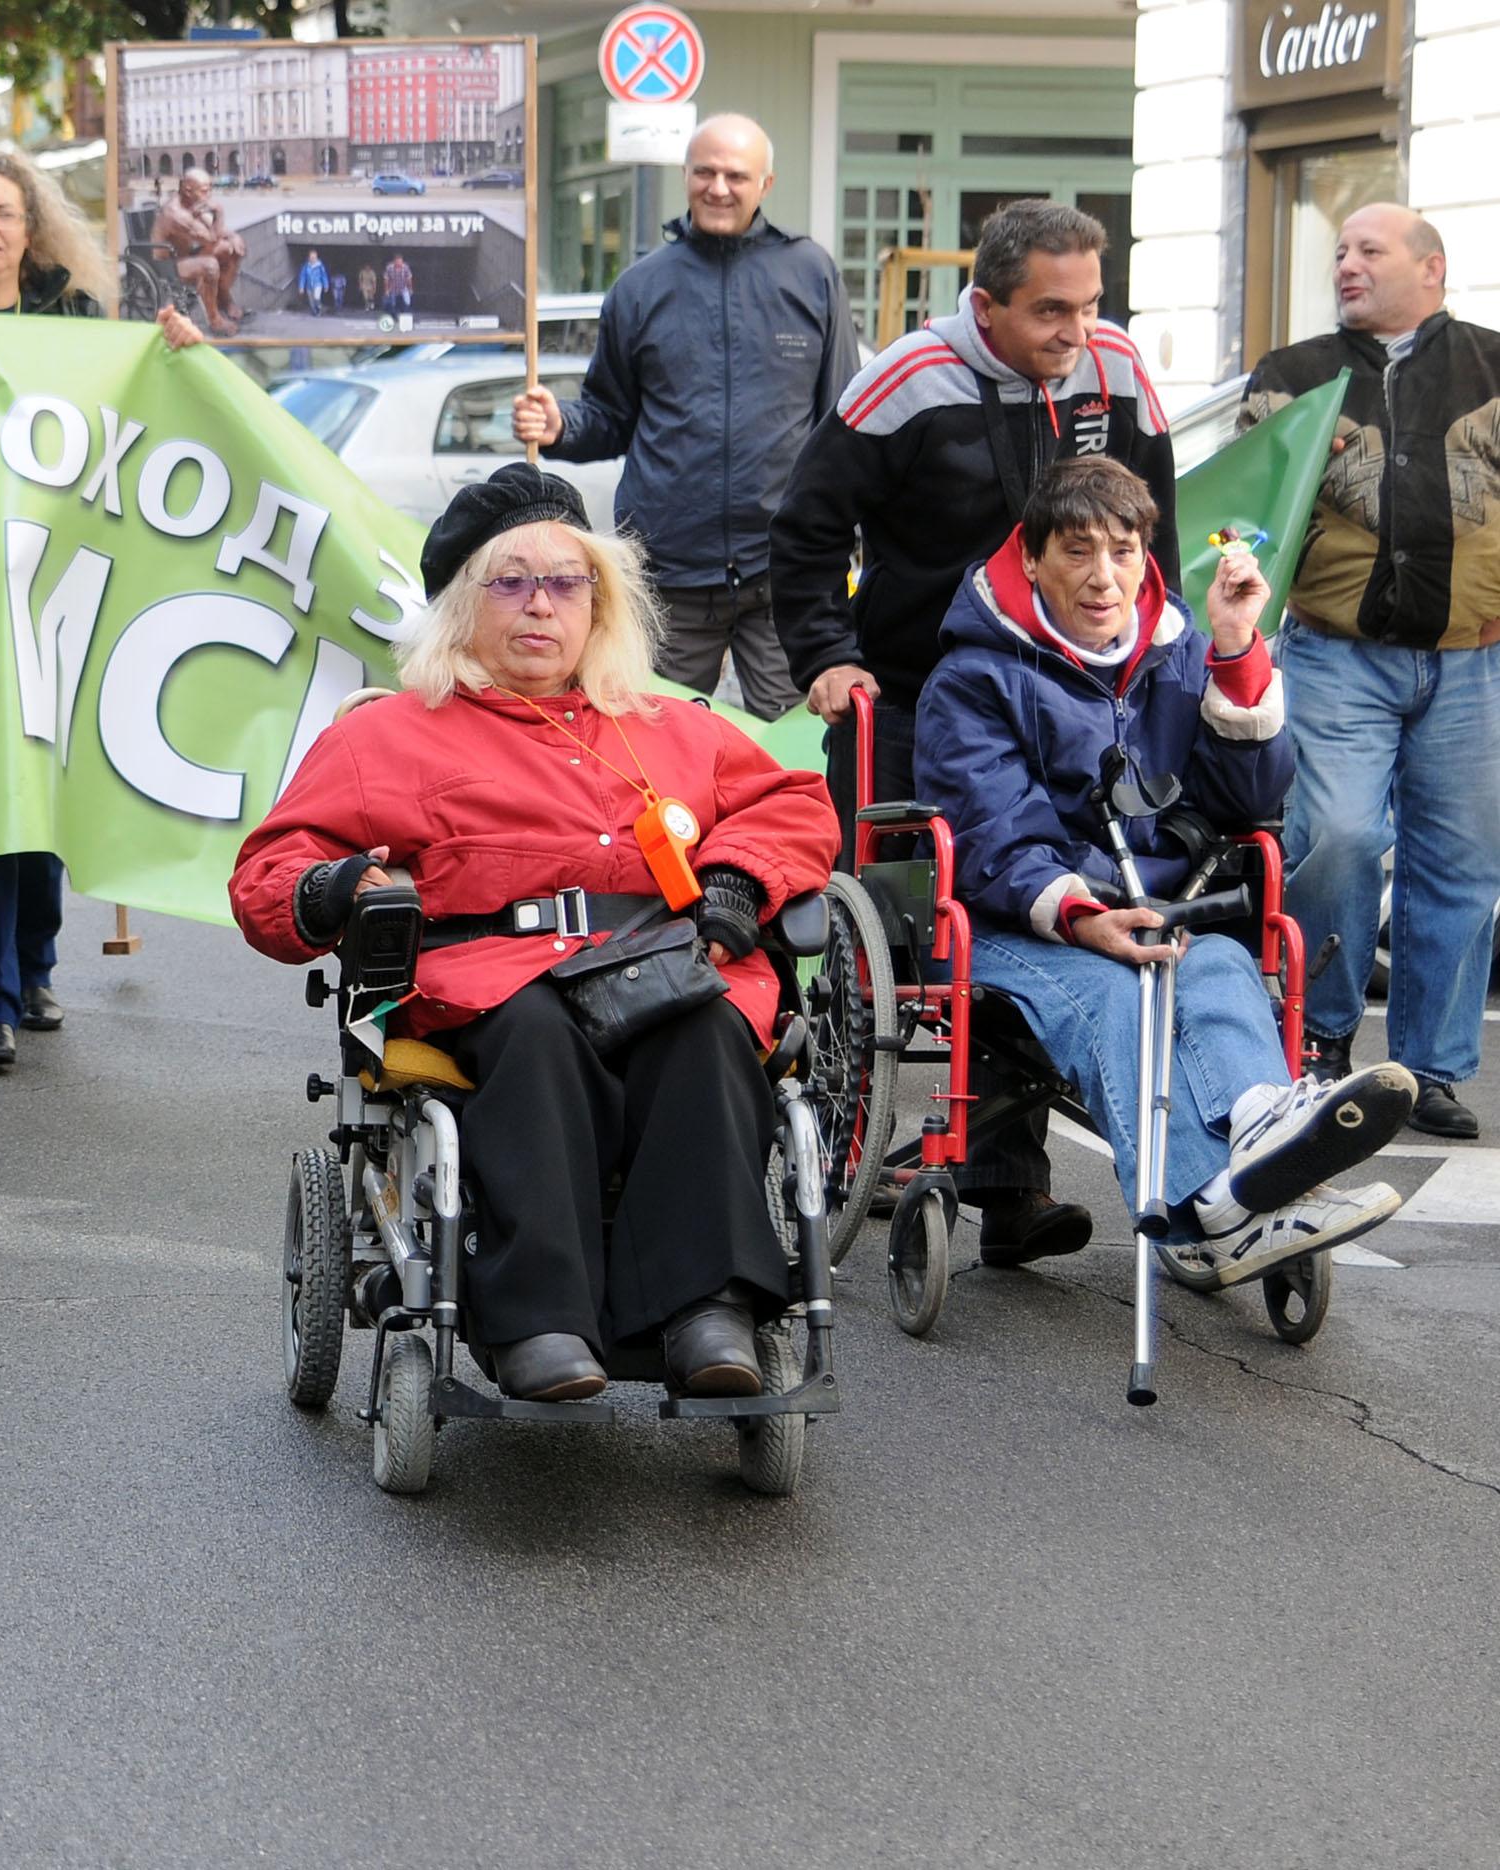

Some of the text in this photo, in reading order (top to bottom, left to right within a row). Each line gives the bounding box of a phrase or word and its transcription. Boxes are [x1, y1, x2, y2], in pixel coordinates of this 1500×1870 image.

[1260, 2, 1377, 78] Cartier
[276, 213, 485, 237] Не съм Роден за тук
[1074, 413, 1111, 458] TR
